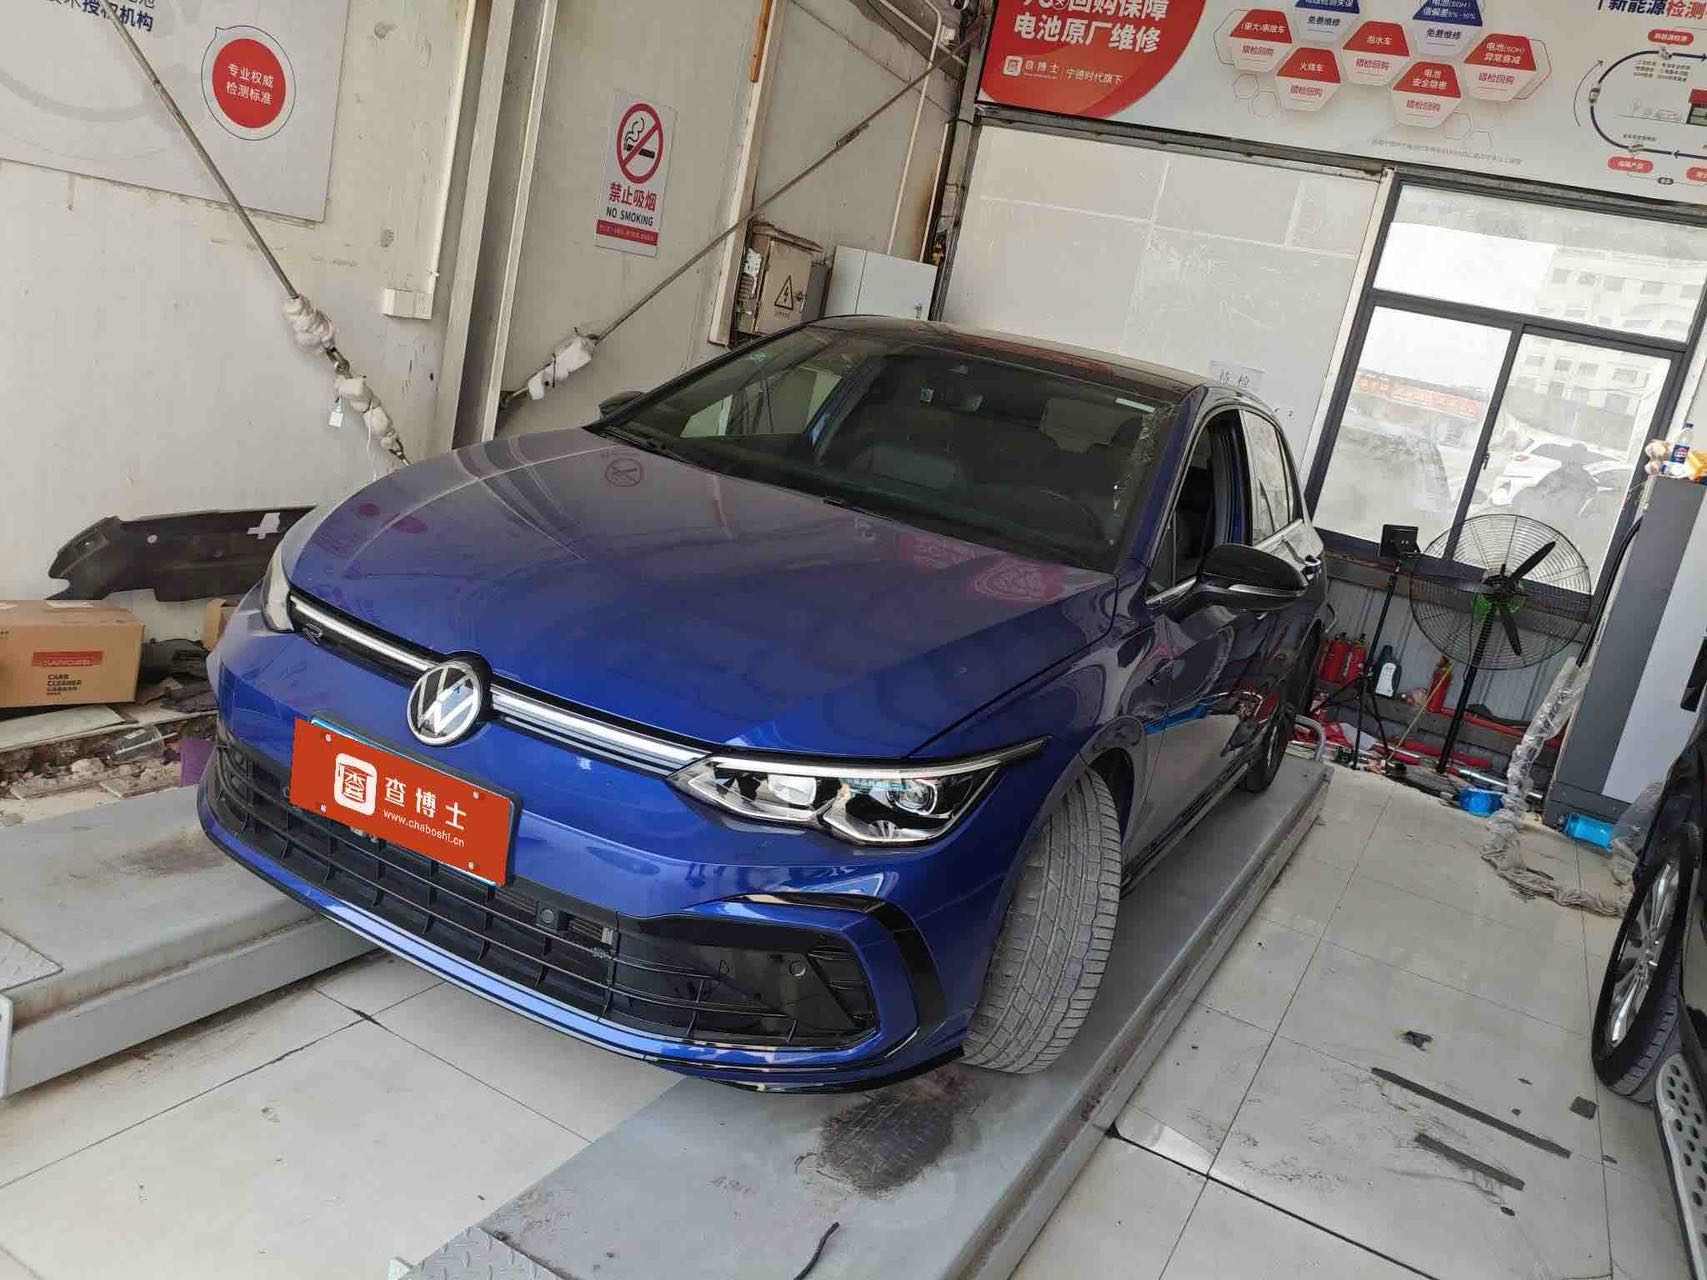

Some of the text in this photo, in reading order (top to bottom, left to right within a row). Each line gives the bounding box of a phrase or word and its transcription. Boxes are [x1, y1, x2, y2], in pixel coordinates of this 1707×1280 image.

[54, 0, 153, 31] 授机构
[1023, 0, 1168, 21] 回购保障
[1608, 0, 1707, 19] 新能源检测
[1014, 12, 1161, 53] 电池原厂维修
[1427, 28, 1462, 40] 免费维修
[227, 64, 274, 88] 专业权威
[1066, 68, 1125, 84] 宁德时代旗下
[226, 82, 272, 105] 检测标准
[609, 181, 657, 212] 禁止吸烟
[606, 206, 654, 227] NO SMOKING
[385, 776, 467, 831] 查博士
[383, 808, 465, 848] www.chaboshi.cn
